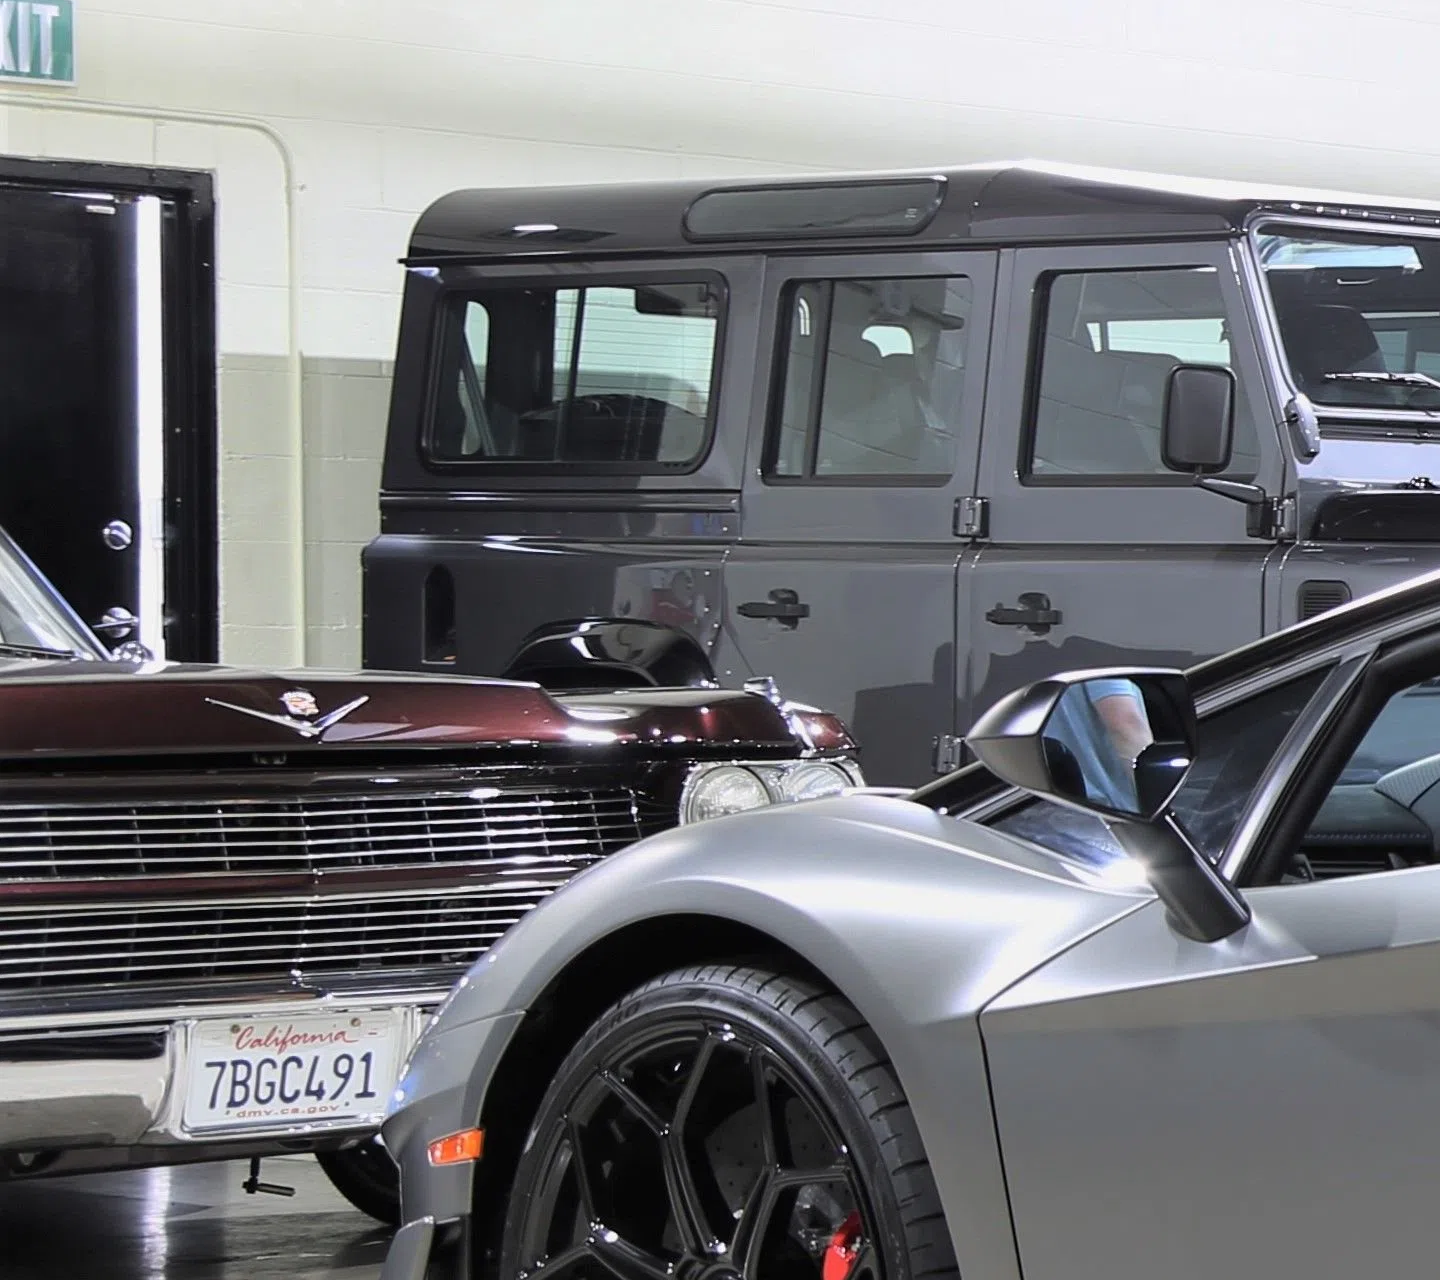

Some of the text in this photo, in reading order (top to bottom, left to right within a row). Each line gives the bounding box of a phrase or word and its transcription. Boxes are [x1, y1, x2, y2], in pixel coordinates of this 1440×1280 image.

[235, 1025, 358, 1053] California
[205, 1052, 376, 1109] 7BGC491
[237, 1105, 341, 1118] dmv.ca.gov
